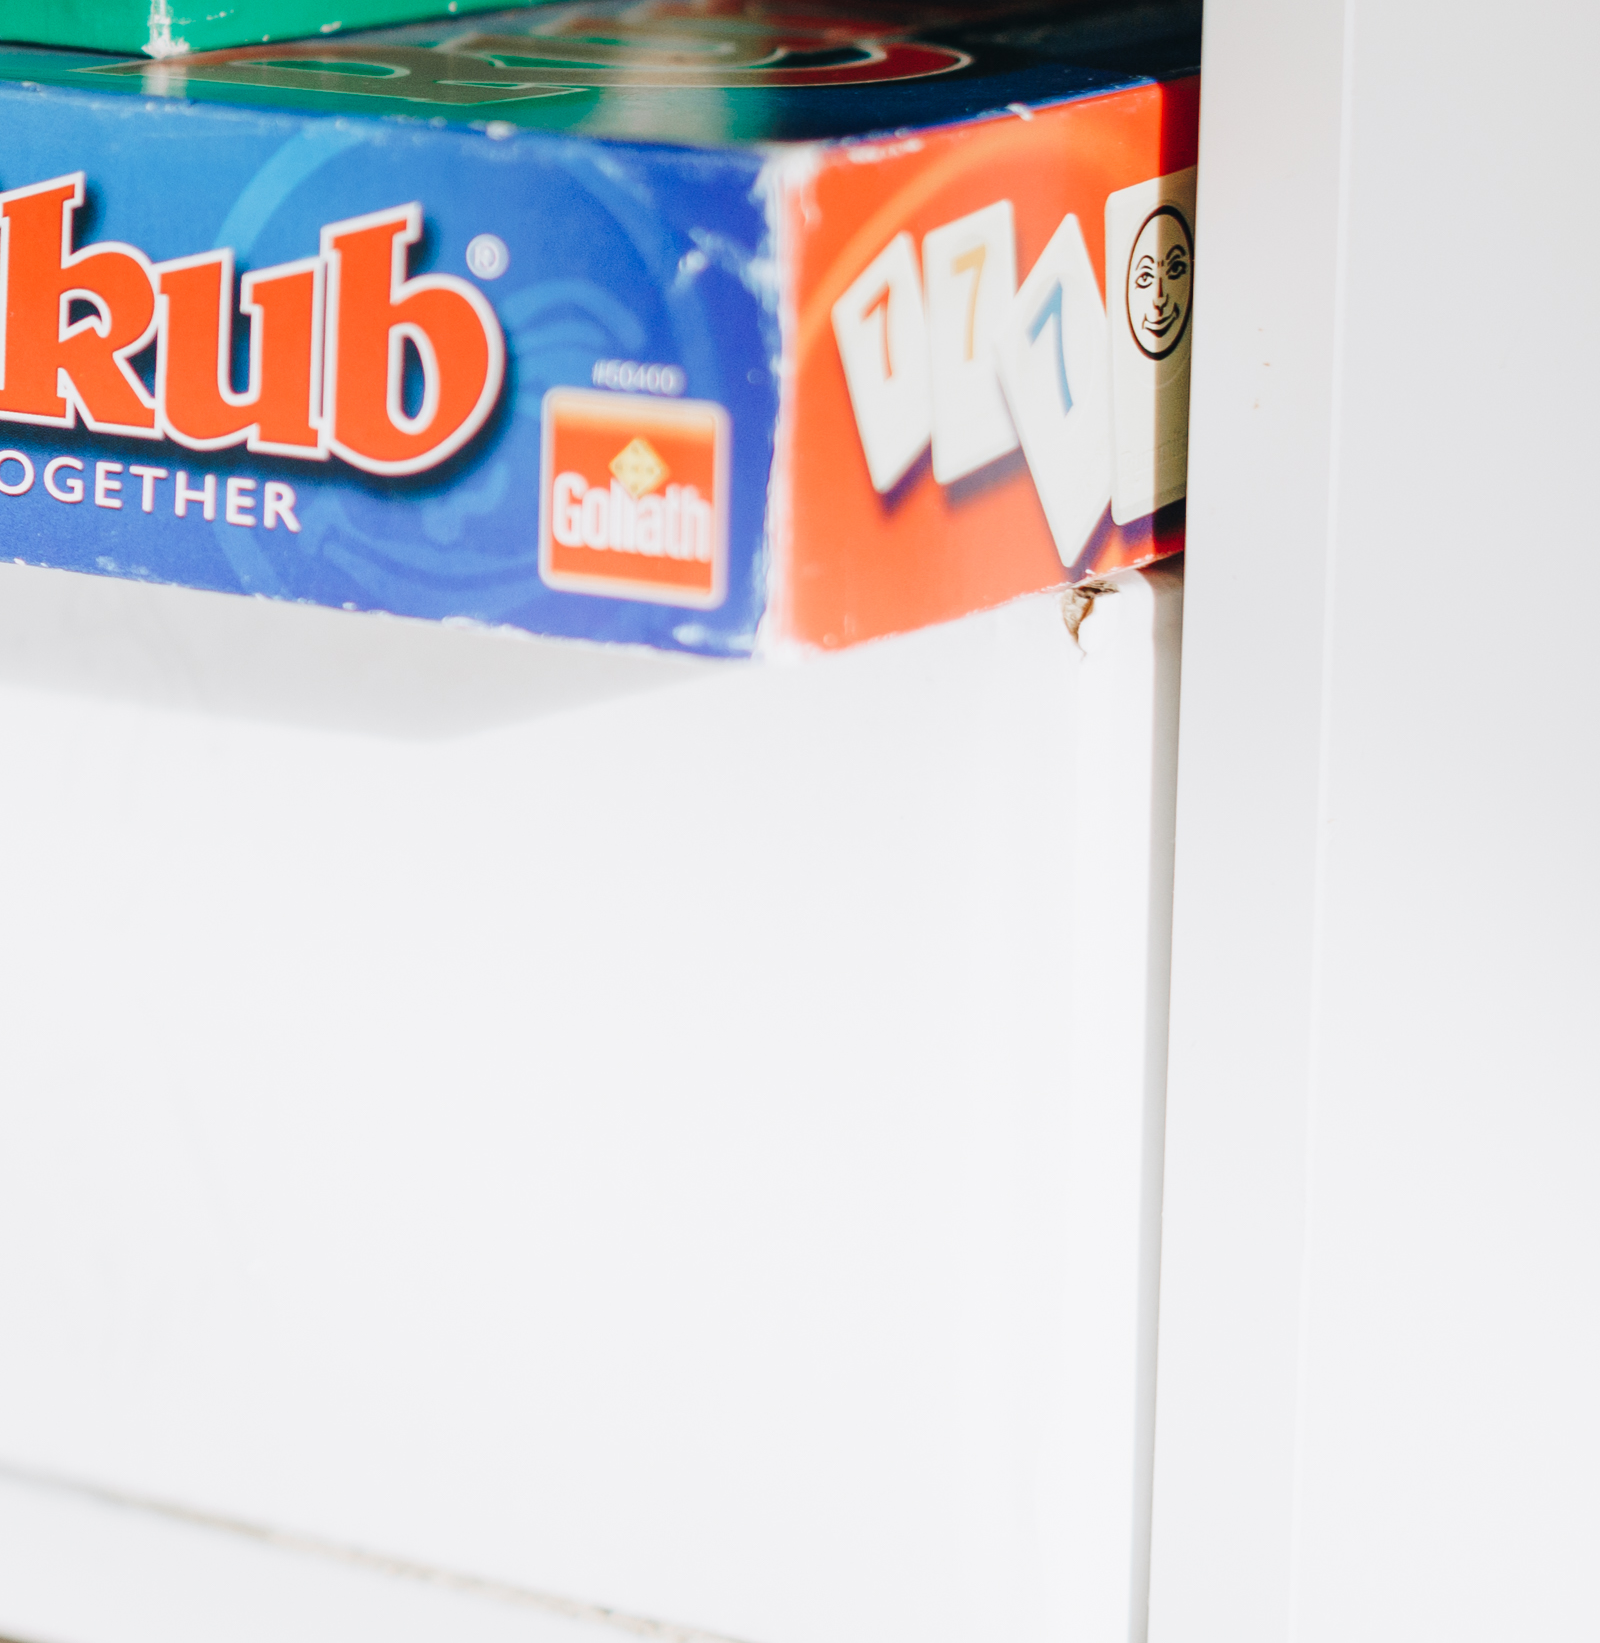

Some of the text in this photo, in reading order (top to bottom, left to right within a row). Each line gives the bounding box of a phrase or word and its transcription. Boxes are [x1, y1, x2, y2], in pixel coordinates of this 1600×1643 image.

[951, 242, 988, 363] 7
[1027, 278, 1074, 419] 7
[552, 470, 713, 563] Goliath
